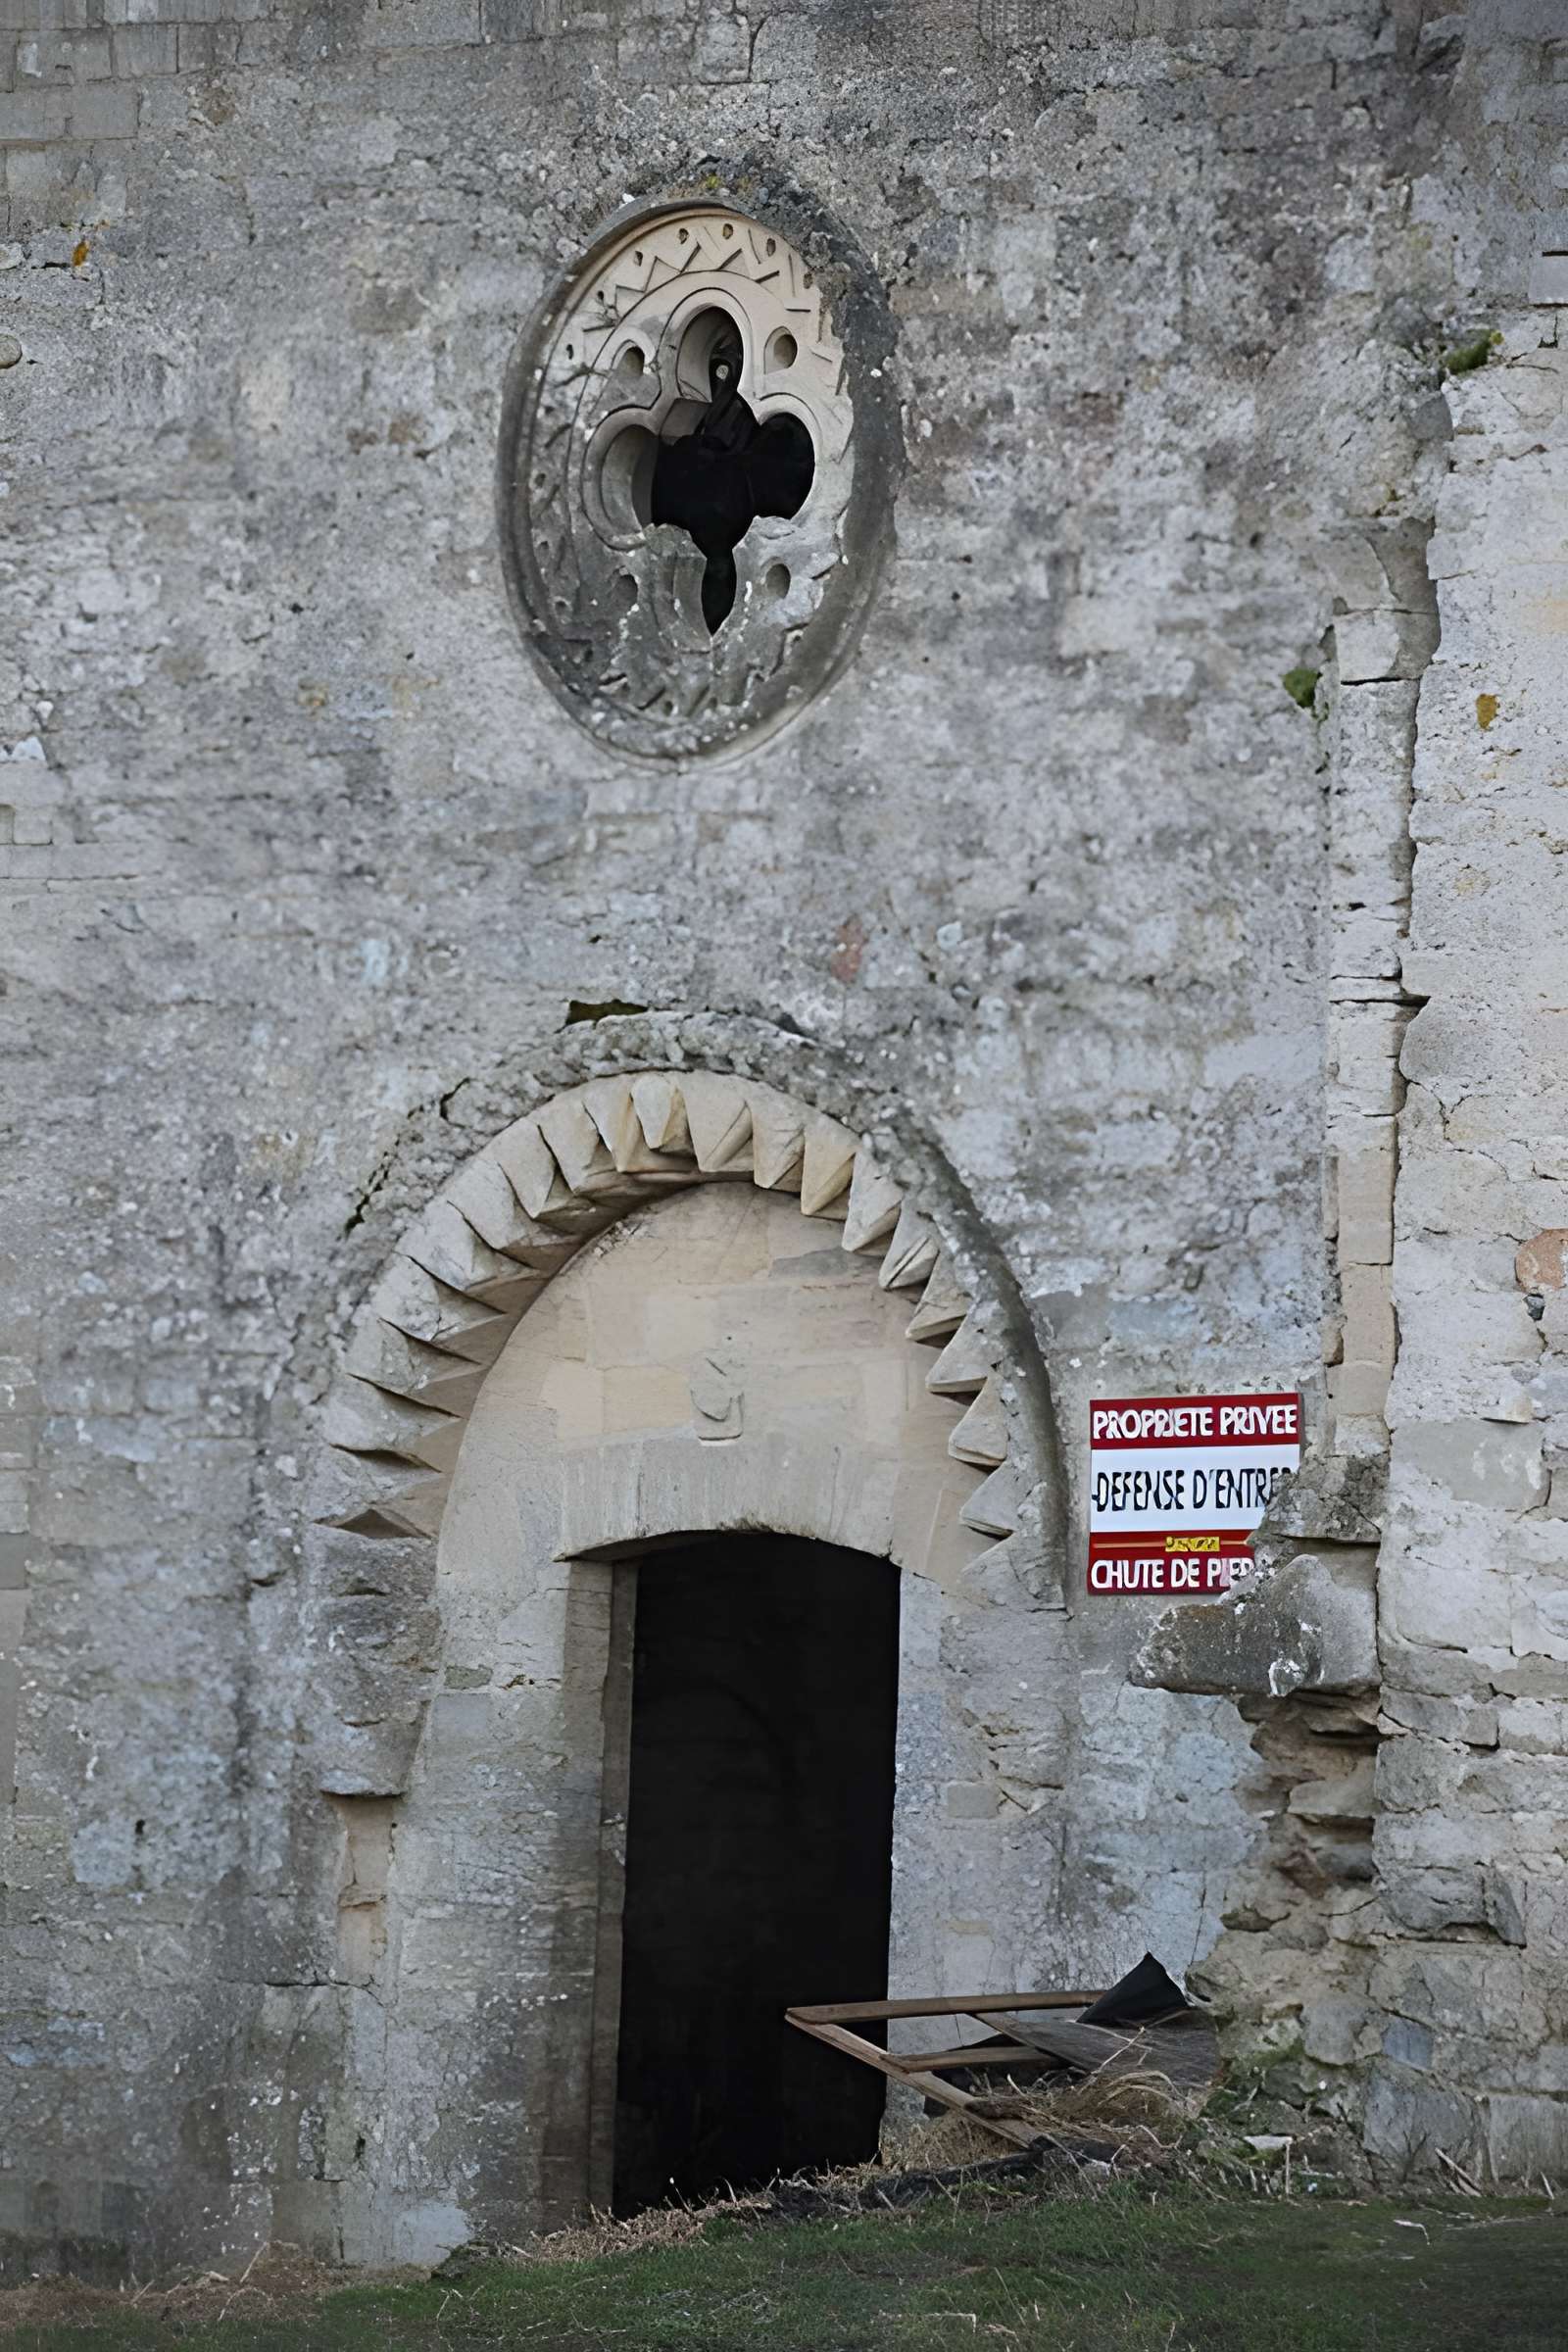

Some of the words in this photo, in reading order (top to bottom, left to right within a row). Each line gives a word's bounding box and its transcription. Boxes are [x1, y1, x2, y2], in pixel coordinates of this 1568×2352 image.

[1093, 1407, 1213, 1439] PROPRIETE
[1219, 1404, 1298, 1436] PRIVEE
[1095, 1470, 1185, 1512] DEFENSE
[1091, 1559, 1164, 1589] CHUTE
[1171, 1558, 1200, 1588] DE
